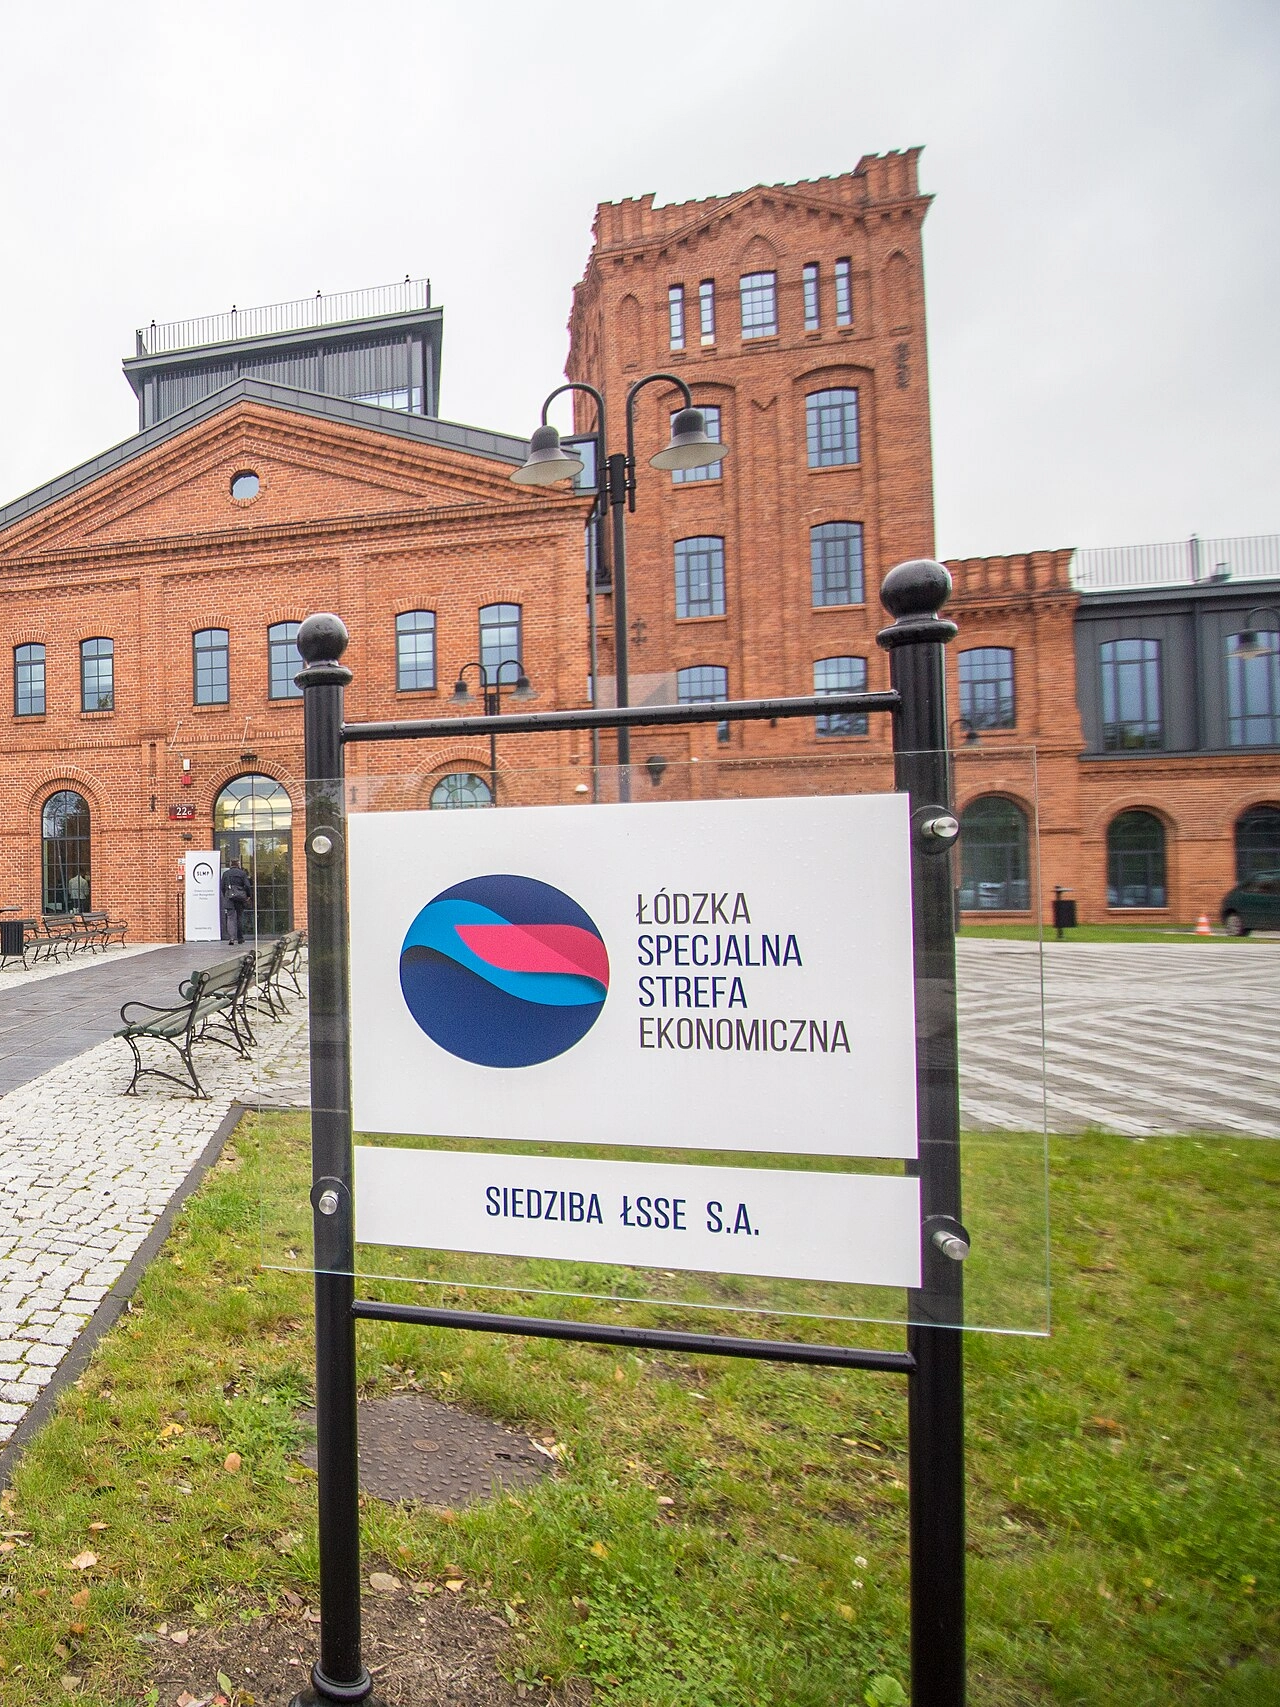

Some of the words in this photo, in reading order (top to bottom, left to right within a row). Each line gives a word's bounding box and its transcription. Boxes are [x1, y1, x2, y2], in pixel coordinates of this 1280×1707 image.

[635, 887, 751, 925] ŁÓDZKA
[637, 934, 803, 967] SPECJALNA
[638, 975, 748, 1009] STREFA
[639, 1017, 851, 1054] EKONOMICZNA
[485, 1186, 604, 1225] SIEDZIBA
[619, 1195, 687, 1231] ŁSSE
[706, 1200, 760, 1236] S.A.
